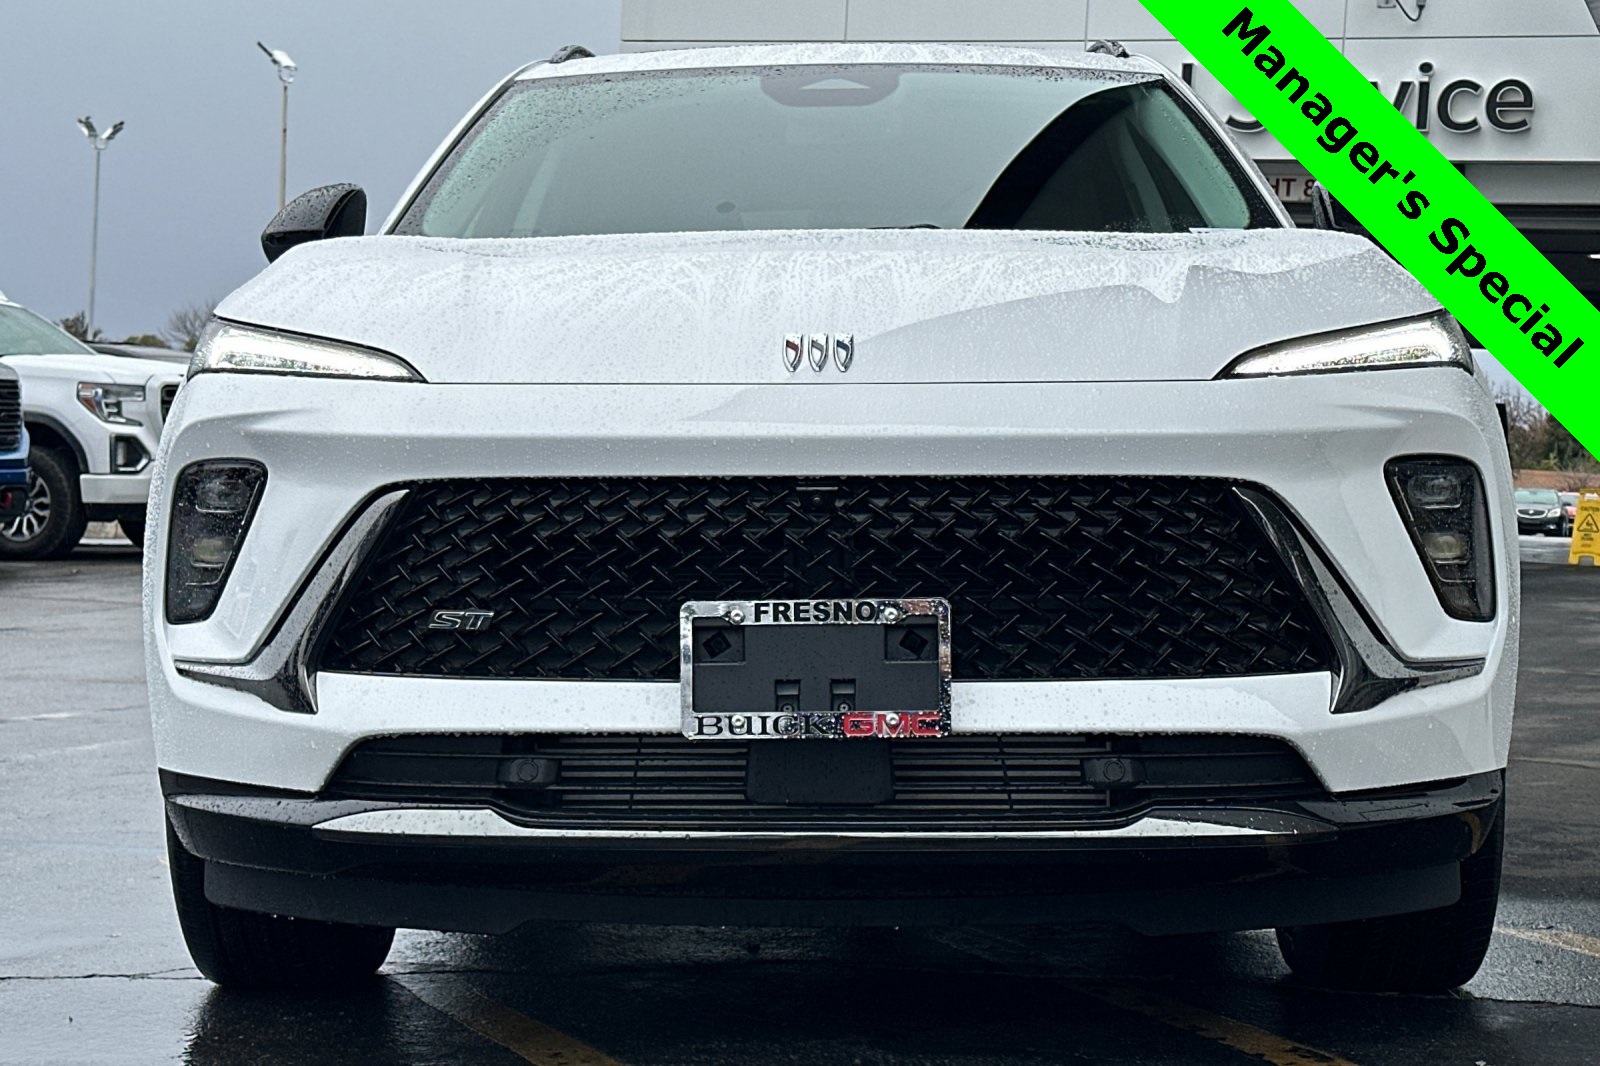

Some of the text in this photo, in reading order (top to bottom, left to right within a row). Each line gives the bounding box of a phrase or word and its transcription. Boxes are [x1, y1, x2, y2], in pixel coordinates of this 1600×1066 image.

[428, 611, 495, 631] ST
[754, 601, 877, 623] FRESNO
[693, 713, 942, 737] BUICK GMC
